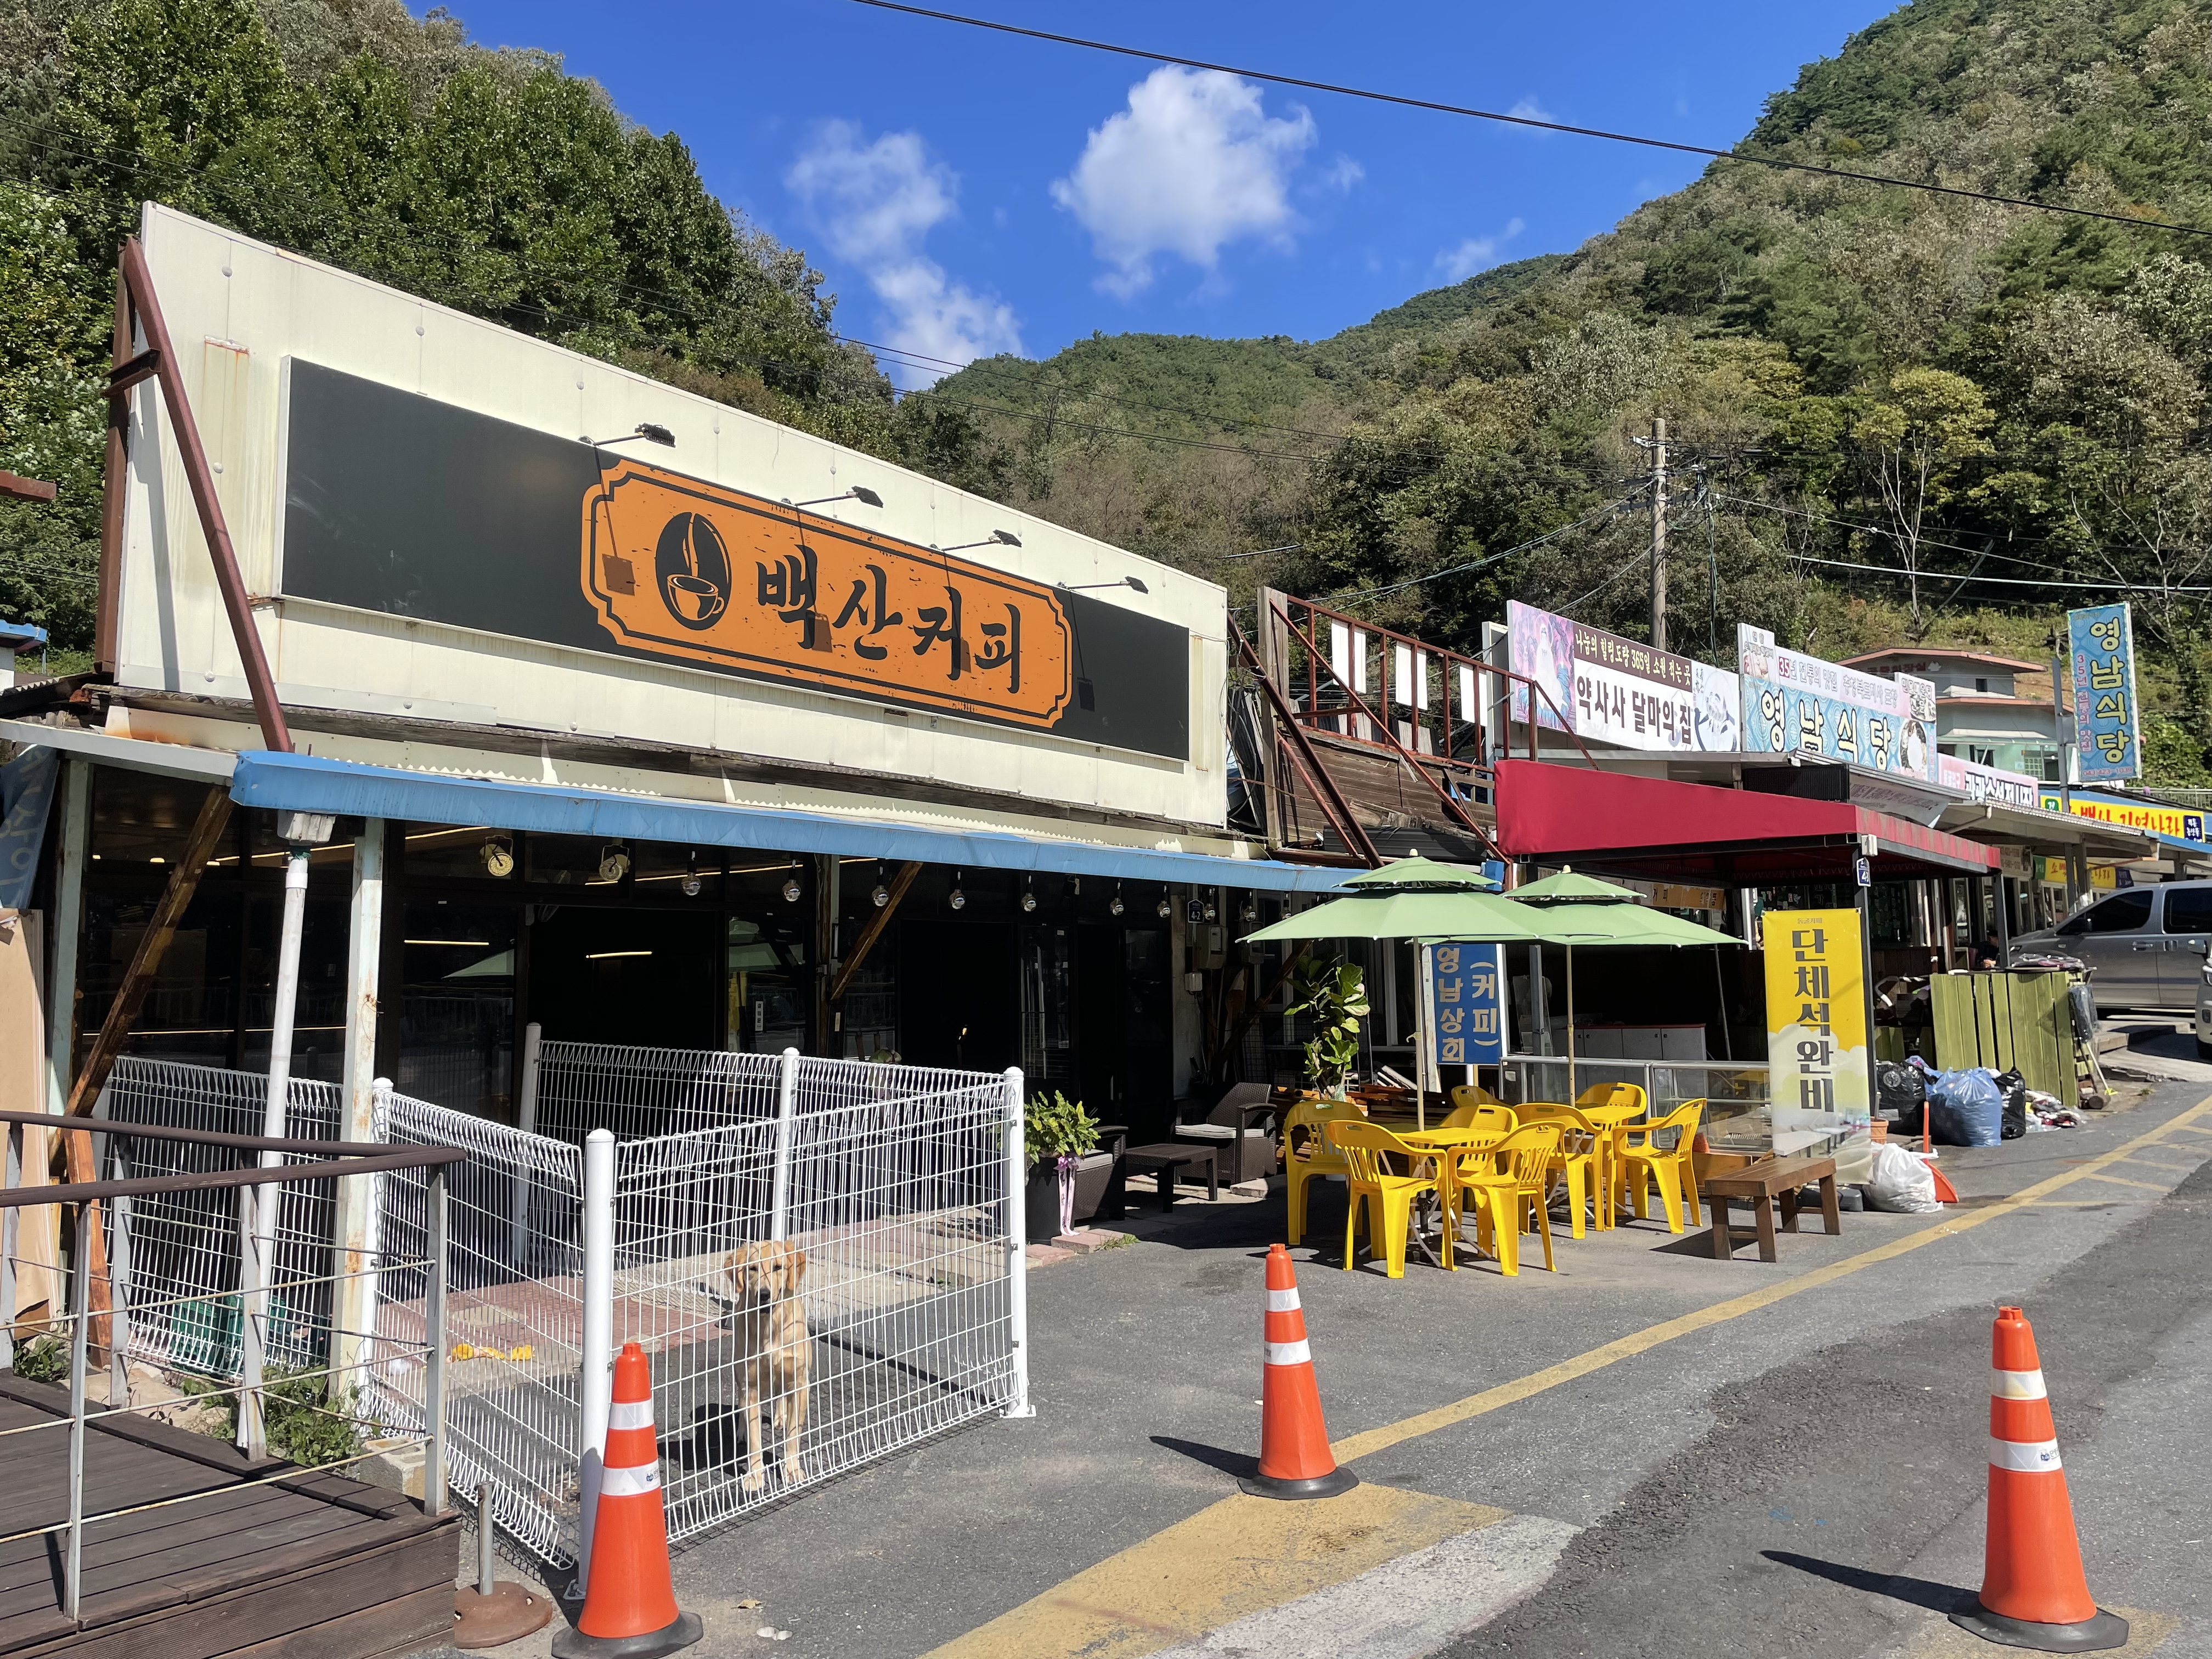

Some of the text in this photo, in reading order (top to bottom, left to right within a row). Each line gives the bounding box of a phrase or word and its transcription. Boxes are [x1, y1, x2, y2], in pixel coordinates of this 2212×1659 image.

[755, 544, 1022, 695] 백산커피
[1575, 629, 1599, 658] 나눔의
[1600, 637, 1629, 669] 힐링도량
[1631, 649, 1651, 674] 365일
[1653, 657, 1667, 679] 소원
[1684, 665, 1691, 686] 곳
[1577, 675, 1692, 745] 약사사 달마의 집
[1779, 656, 1797, 680] 35년
[1799, 662, 1821, 688] 전통의
[1823, 669, 1838, 692] 맛집
[2075, 654, 2092, 752] 35년 전통의 맛집
[2090, 617, 2131, 764] 영남식당
[1761, 688, 1892, 771] 영남식당
[1436, 947, 1499, 1063] 영남상회 (커피)
